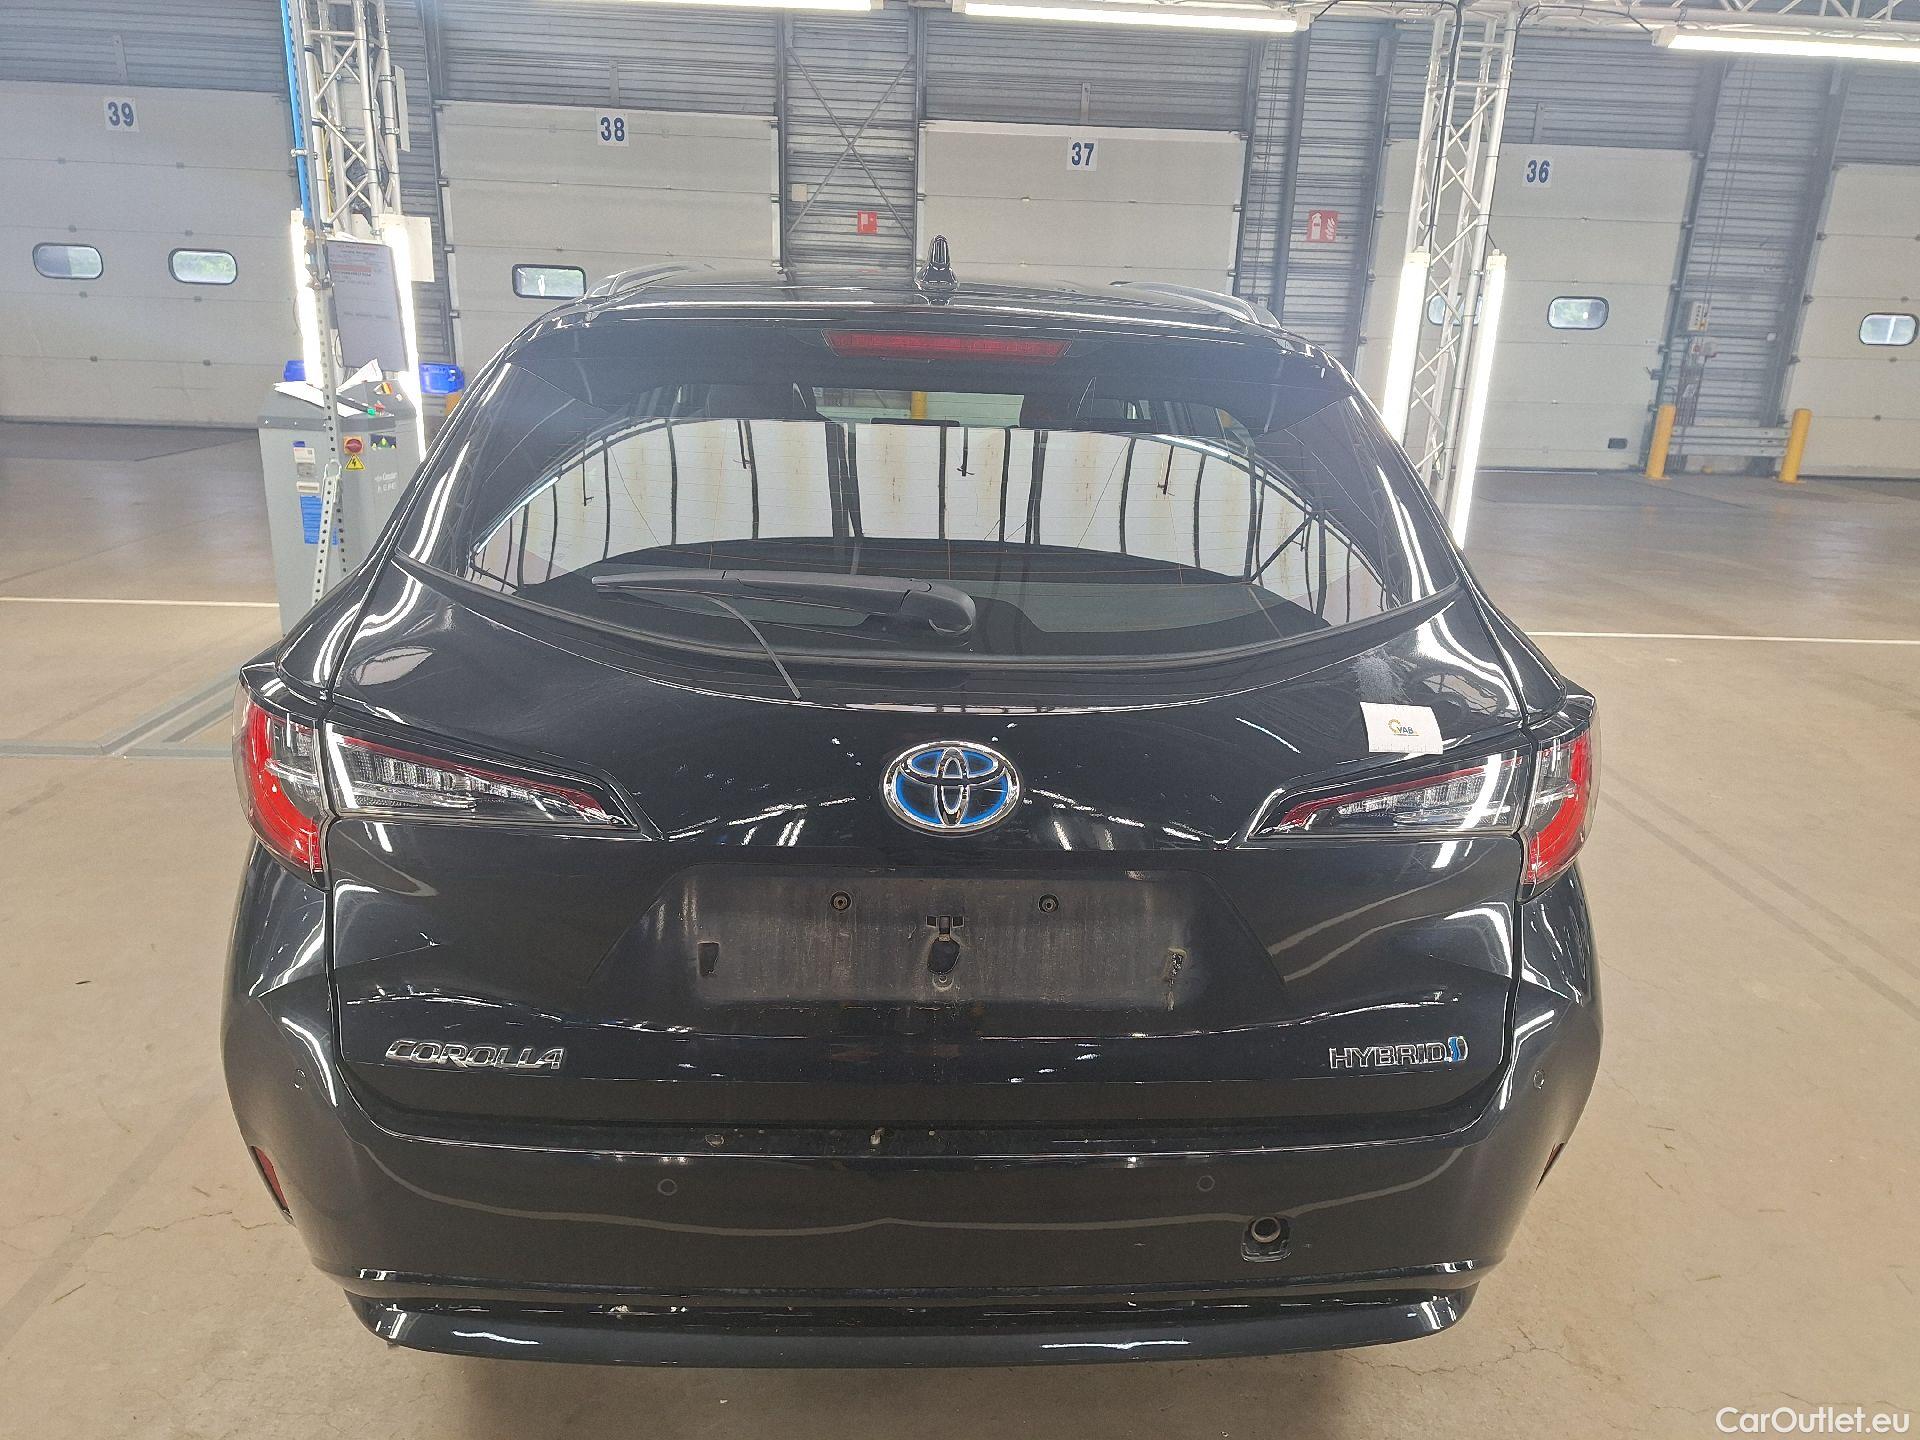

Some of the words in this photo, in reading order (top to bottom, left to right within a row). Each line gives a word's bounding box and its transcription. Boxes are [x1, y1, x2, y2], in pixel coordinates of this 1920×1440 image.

[108, 101, 134, 127] 39
[600, 116, 625, 141] 38
[1071, 141, 1095, 166] 37
[1526, 160, 1550, 183] 36
[385, 1039, 566, 1070] COROLLA
[1328, 1042, 1448, 1069] HYBRID
